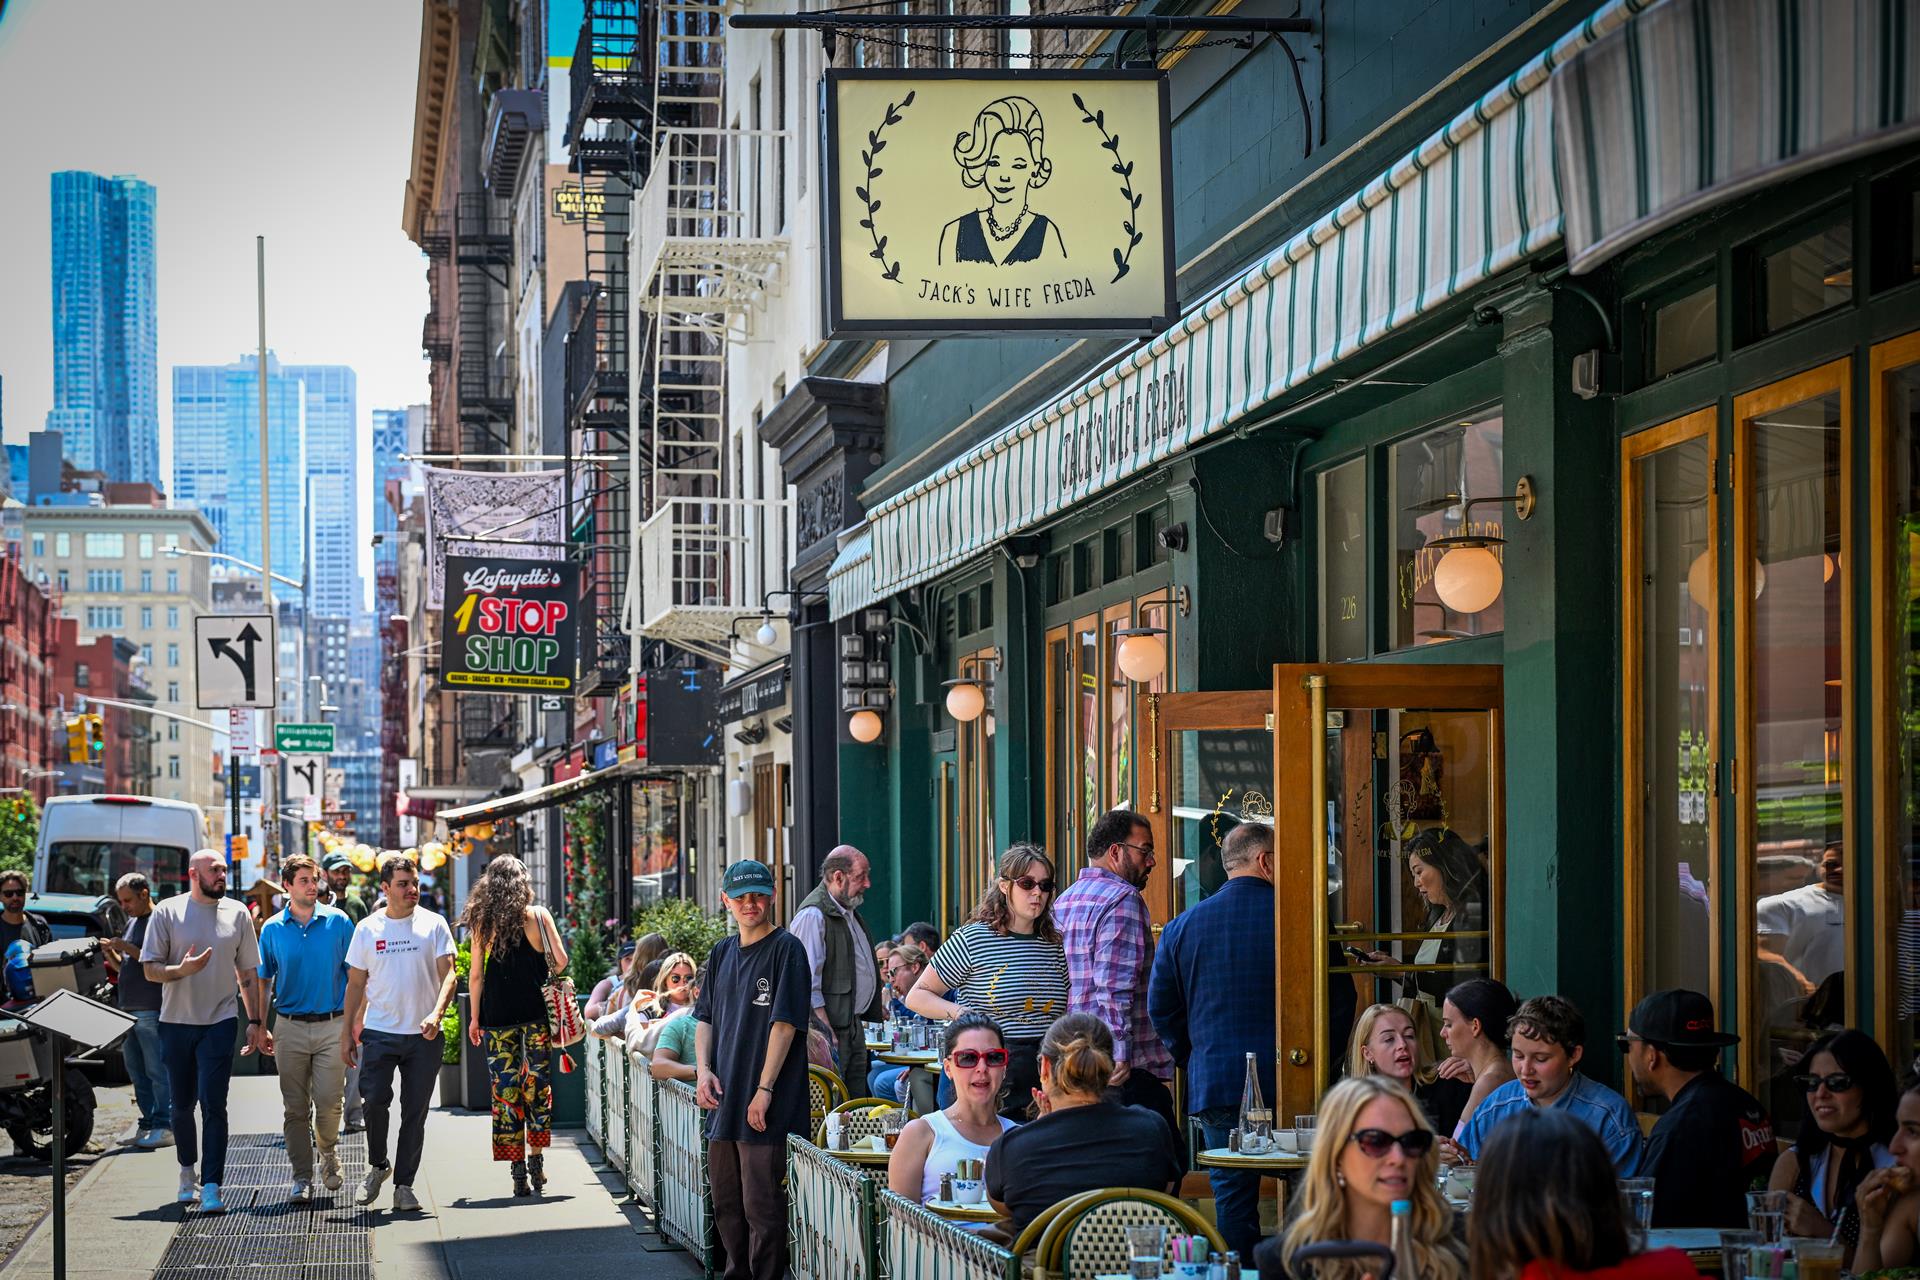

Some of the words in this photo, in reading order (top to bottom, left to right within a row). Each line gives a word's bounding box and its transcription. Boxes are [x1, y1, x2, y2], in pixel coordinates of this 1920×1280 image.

[918, 279, 976, 305] JACK'S
[988, 287, 1031, 308] WIFE
[1043, 277, 1096, 305] FREDA
[1062, 412, 1103, 490] JACK'S
[1108, 391, 1140, 466] WIFE
[1145, 363, 1187, 448] FREDA
[463, 567, 561, 593] Lafayette's
[453, 593, 478, 635] 1
[478, 597, 568, 635] STOP
[1341, 595, 1357, 619] 226
[465, 637, 560, 674] SHOP
[277, 727, 333, 737] Williamsburg
[305, 739, 331, 749] Bridge
